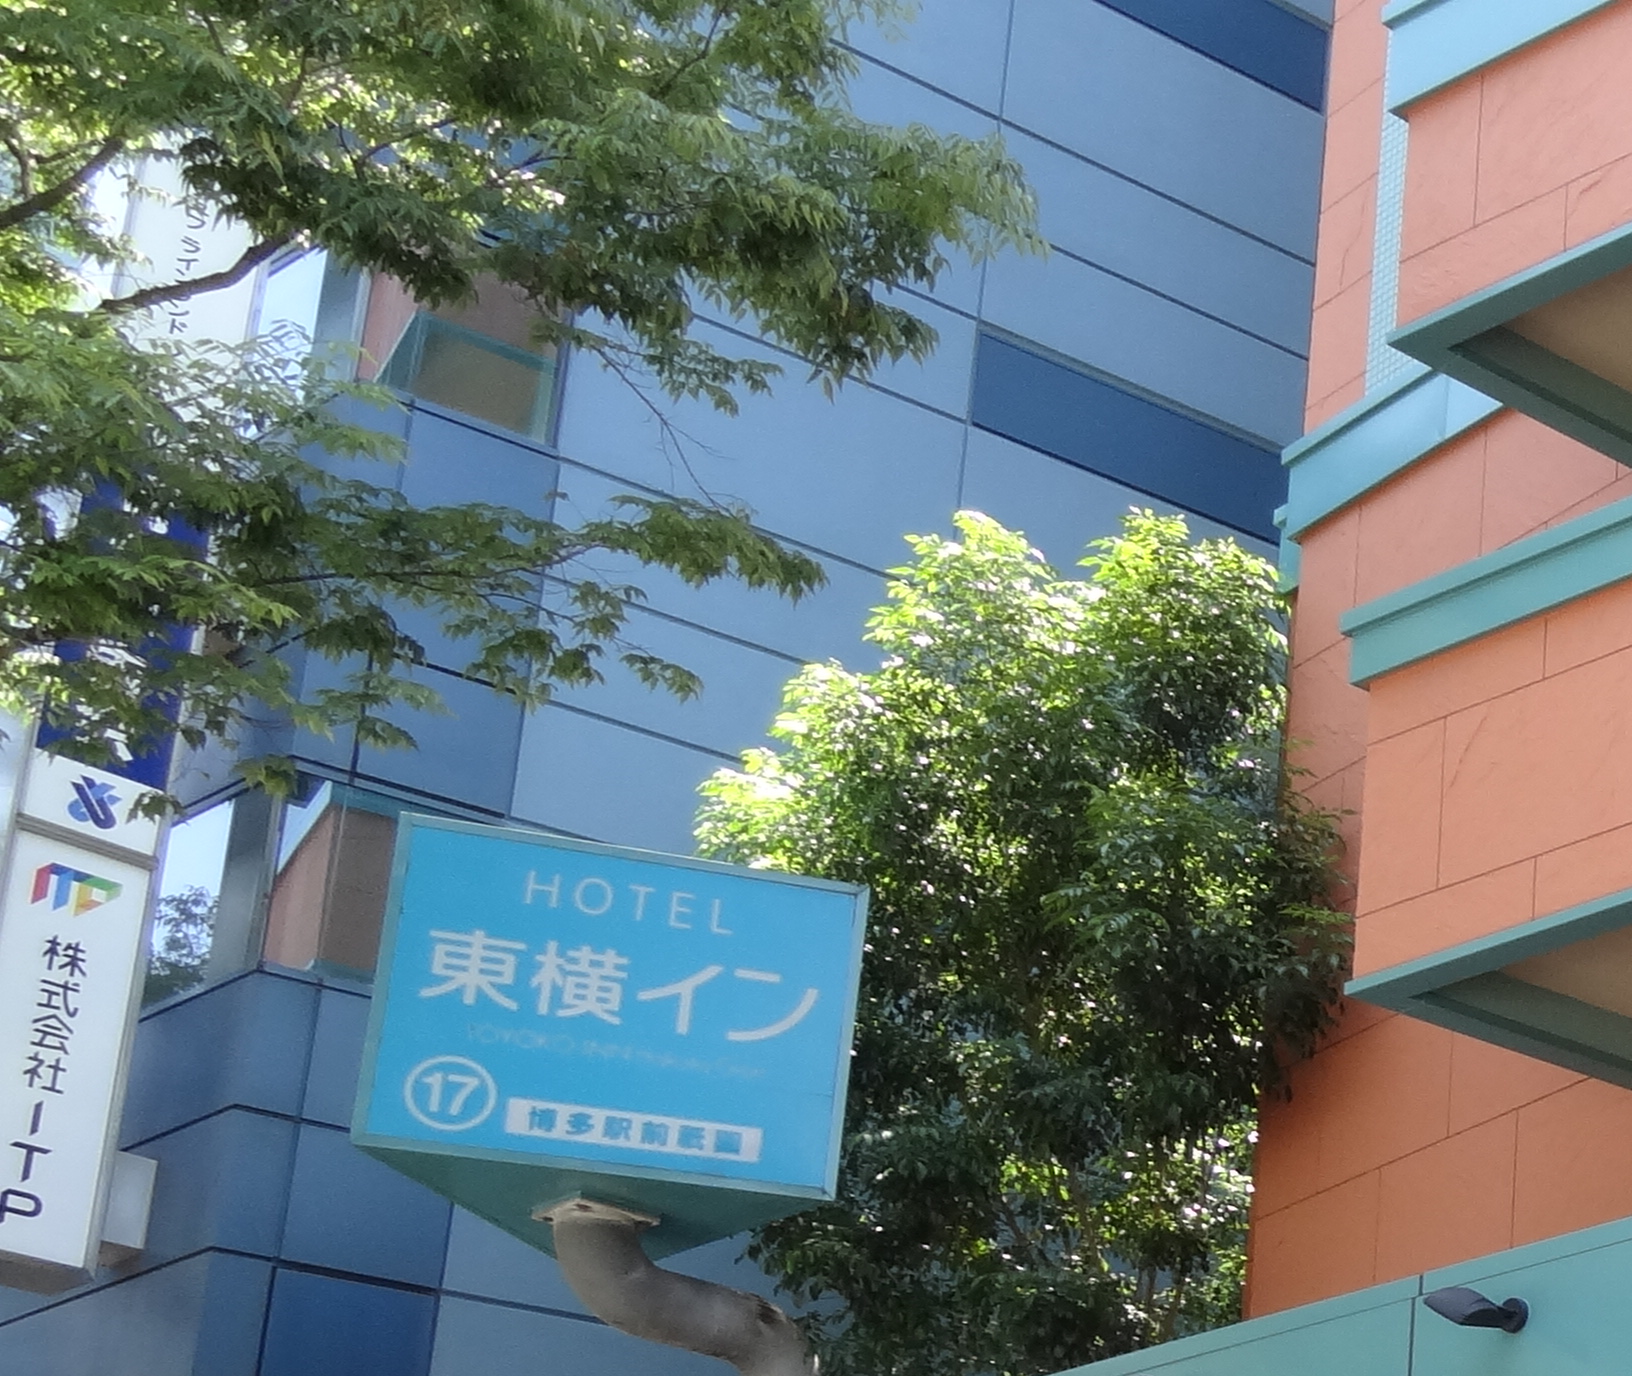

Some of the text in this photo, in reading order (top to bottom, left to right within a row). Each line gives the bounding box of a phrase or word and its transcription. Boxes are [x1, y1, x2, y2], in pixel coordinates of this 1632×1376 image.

[522, 869, 734, 936] HOTEL
[418, 928, 821, 1043] 東横イン
